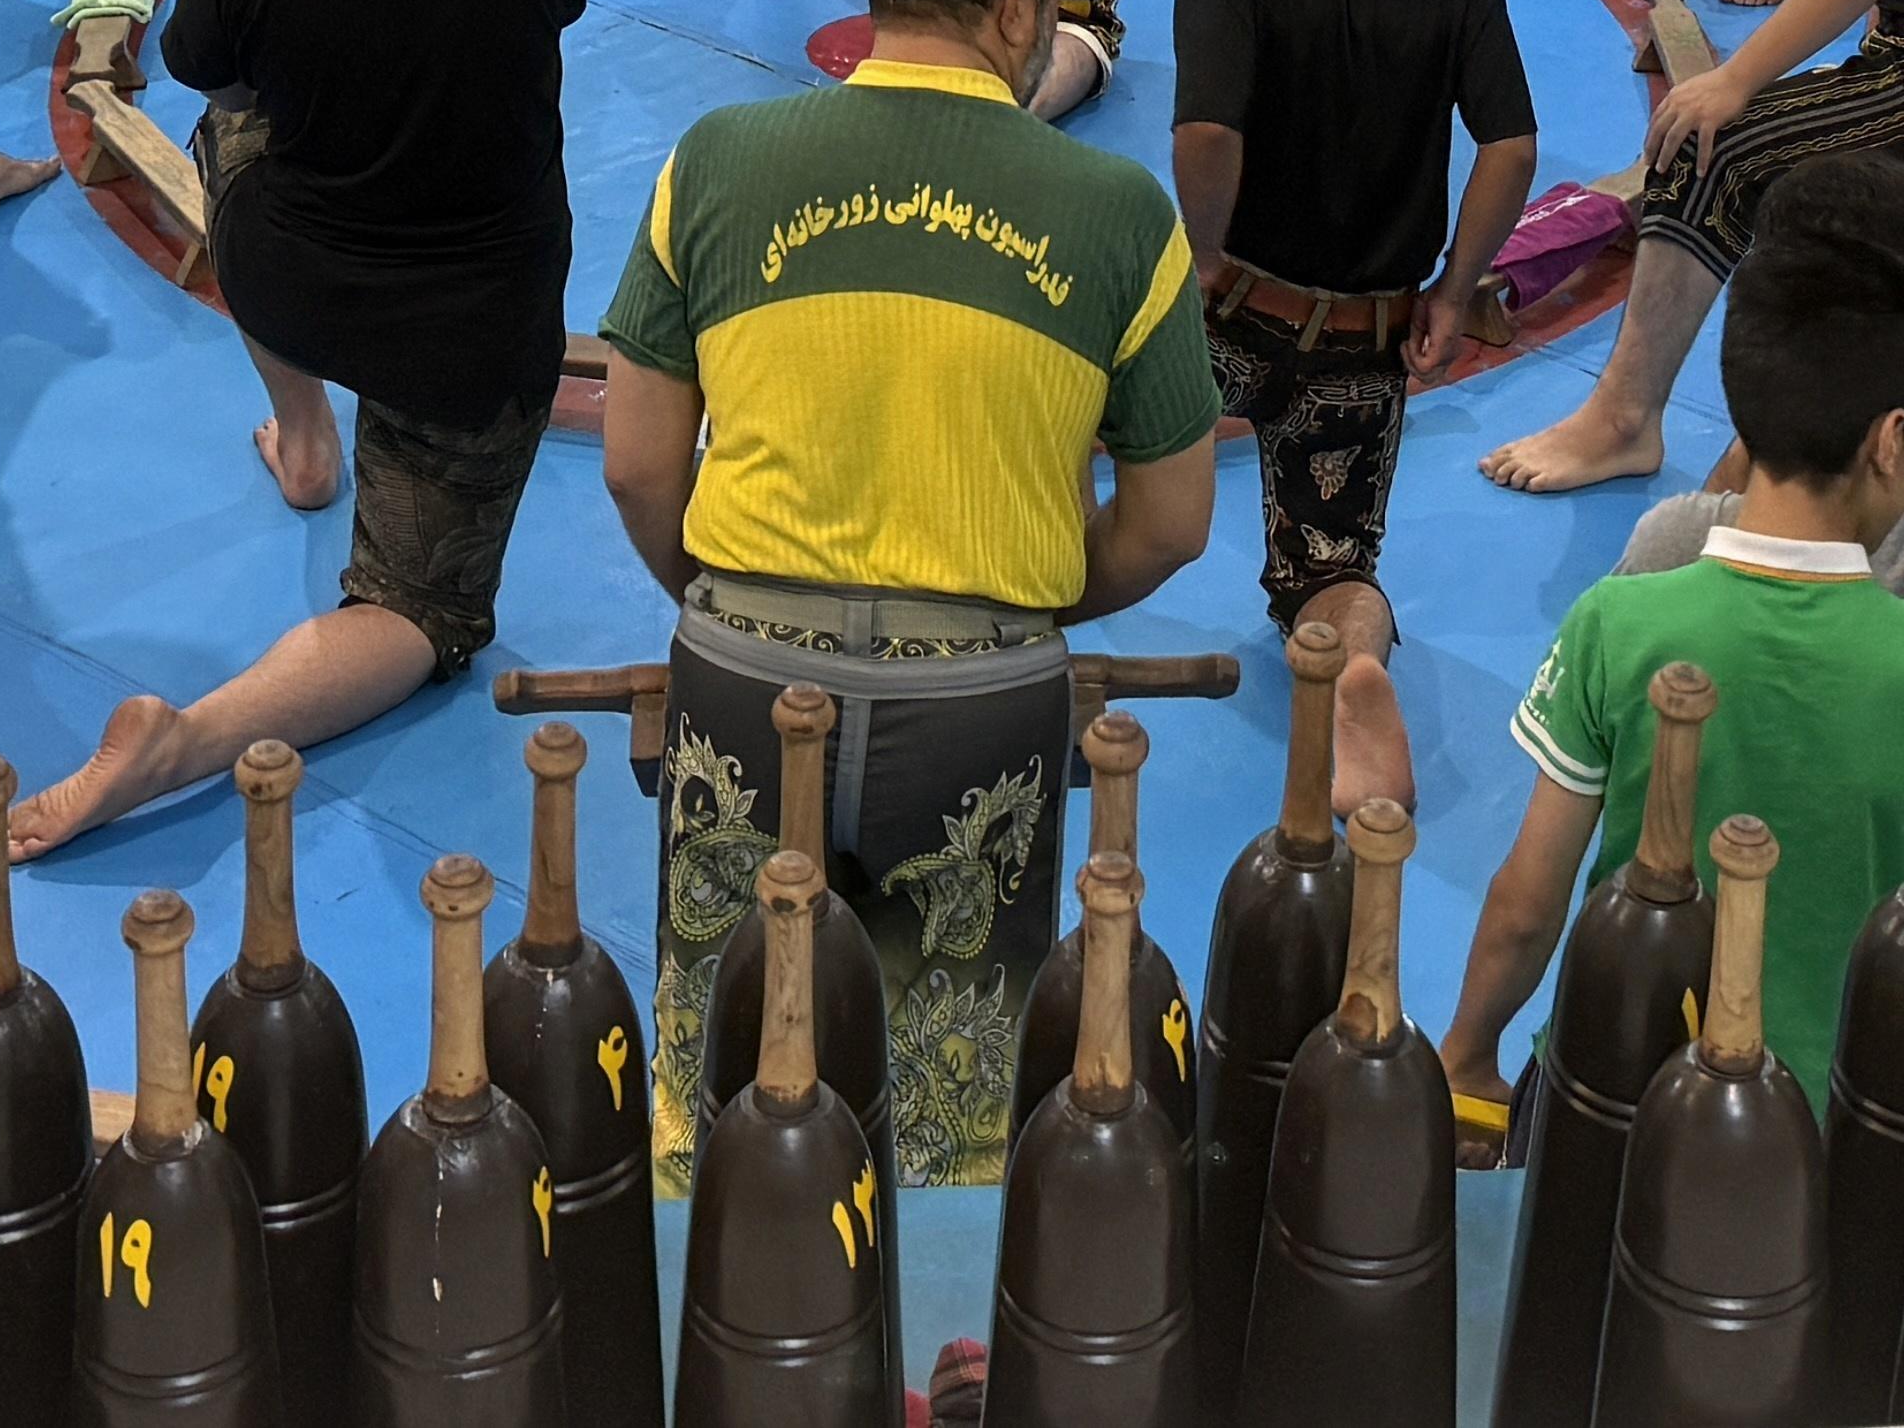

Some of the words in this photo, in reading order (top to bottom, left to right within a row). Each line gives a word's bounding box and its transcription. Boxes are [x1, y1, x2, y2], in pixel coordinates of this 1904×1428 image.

[883, 181, 974, 241] پهلوانی
[975, 207, 1074, 307] فدراسیون
[99, 1210, 153, 1309] ۱۹
